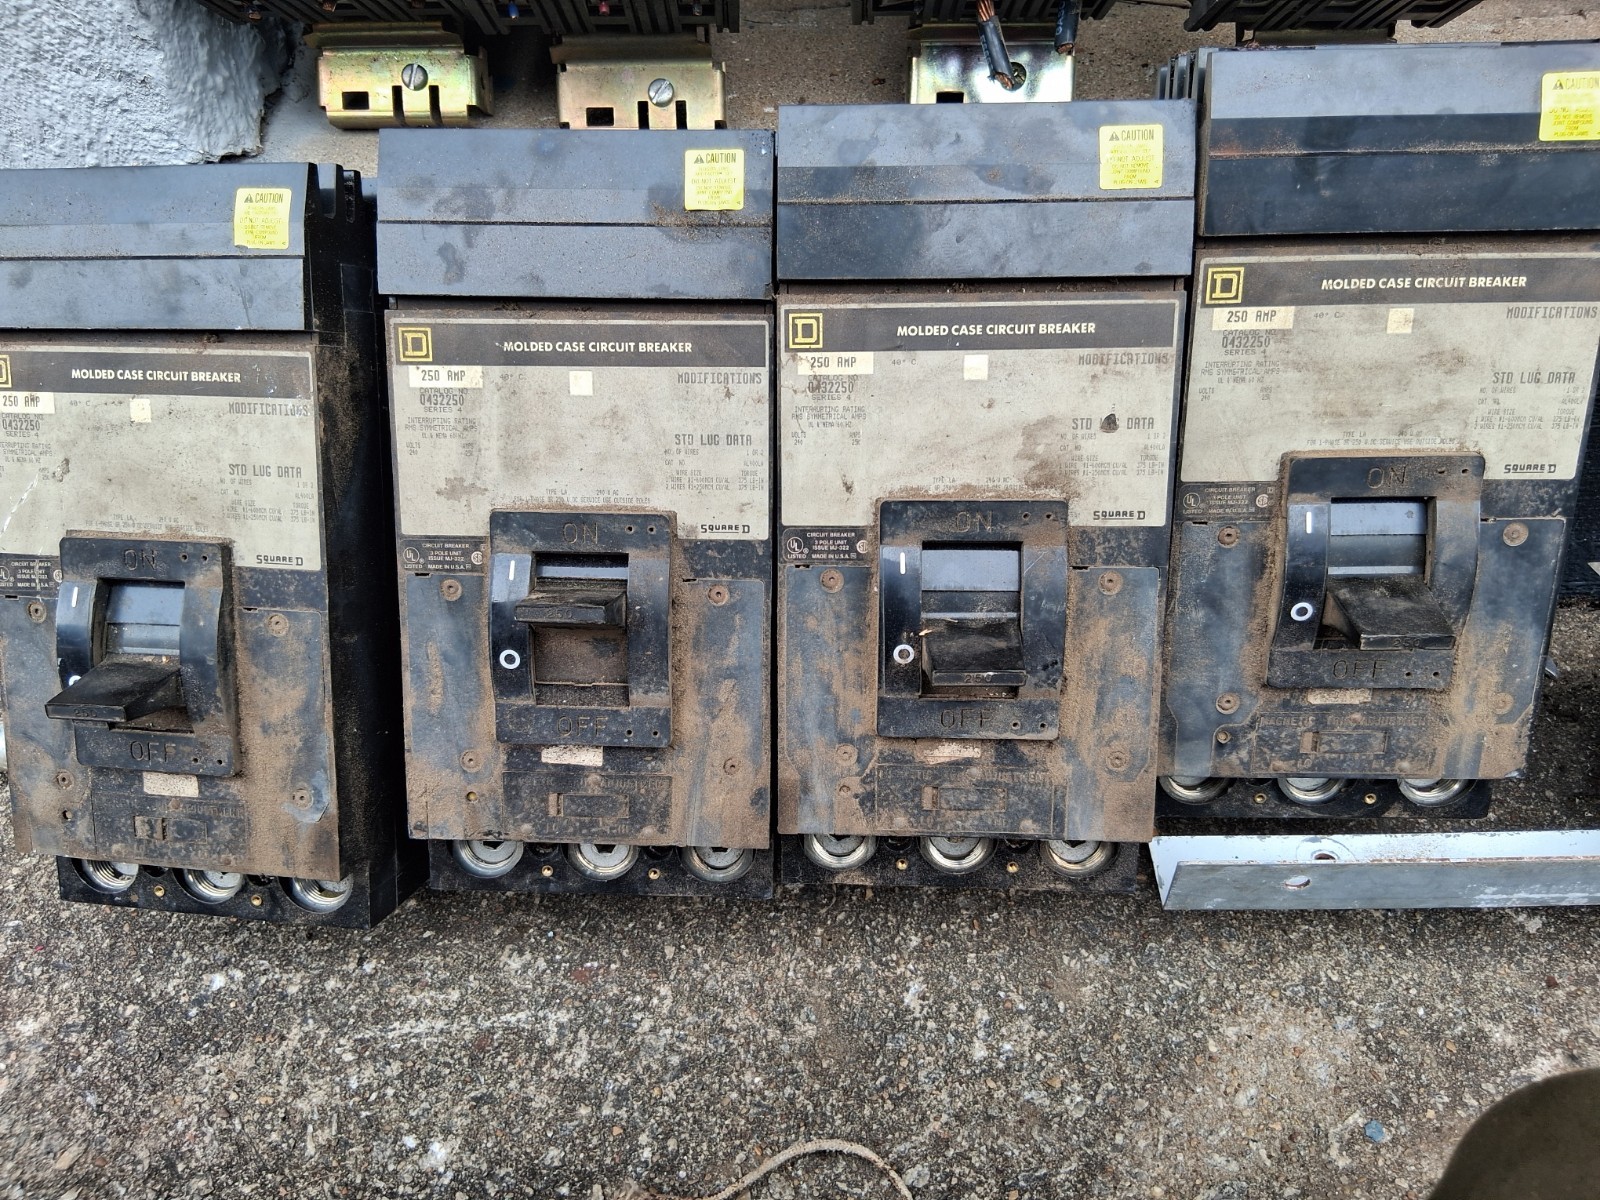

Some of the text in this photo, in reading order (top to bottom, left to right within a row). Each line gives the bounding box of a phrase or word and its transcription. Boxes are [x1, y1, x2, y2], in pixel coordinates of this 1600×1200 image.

[1121, 129, 1154, 141] CAUTION
[705, 153, 736, 163] CAUTION
[255, 192, 283, 203] CAUTION
[1321, 276, 1527, 290] MOLDED CASE CIRCUIT BREAKER
[1227, 310, 1277, 323] 250 AMP
[1506, 306, 1598, 319] MODIFICATIONS
[897, 323, 1096, 337] MOLDED CASE CIRCUIT BREAKER
[503, 341, 692, 353] MOLDED CASE CIRCUIT BREAKER
[810, 356, 857, 368] 250 AMP
[1079, 352, 1169, 365] MODIFICATIONS
[1204, 360, 1280, 369] INTERRUPTING RATING
[72, 369, 241, 383] MOLDED CASE CIRCUIT BREAKER
[421, 370, 466, 381] 250 AMP
[677, 372, 762, 384] MODIFICATIONS
[1493, 372, 1576, 384] STD LUG DATA
[2, 395, 40, 407] 250 AMP
[228, 402, 308, 416] MODIFICATIONS
[1071, 418, 1092, 430] STD
[1127, 417, 1154, 430] DATA
[674, 433, 752, 446] STD LUG DATA
[229, 464, 302, 478] STD LUG DATA
[1504, 464, 1556, 473] SQUARE D
[1368, 466, 1406, 489] ON
[956, 511, 992, 532] ON
[1093, 510, 1146, 520] SQUARE D
[563, 522, 598, 544] ON
[700, 524, 750, 533] SQUARE D
[790, 540, 799, 551] UL
[123, 549, 156, 570] ON
[256, 554, 303, 566] SQUARE D
[406, 550, 416, 561] UL
[1333, 659, 1387, 680] OFF
[940, 709, 993, 728] OFF
[557, 716, 608, 737] OFF
[130, 741, 177, 764] OFF
